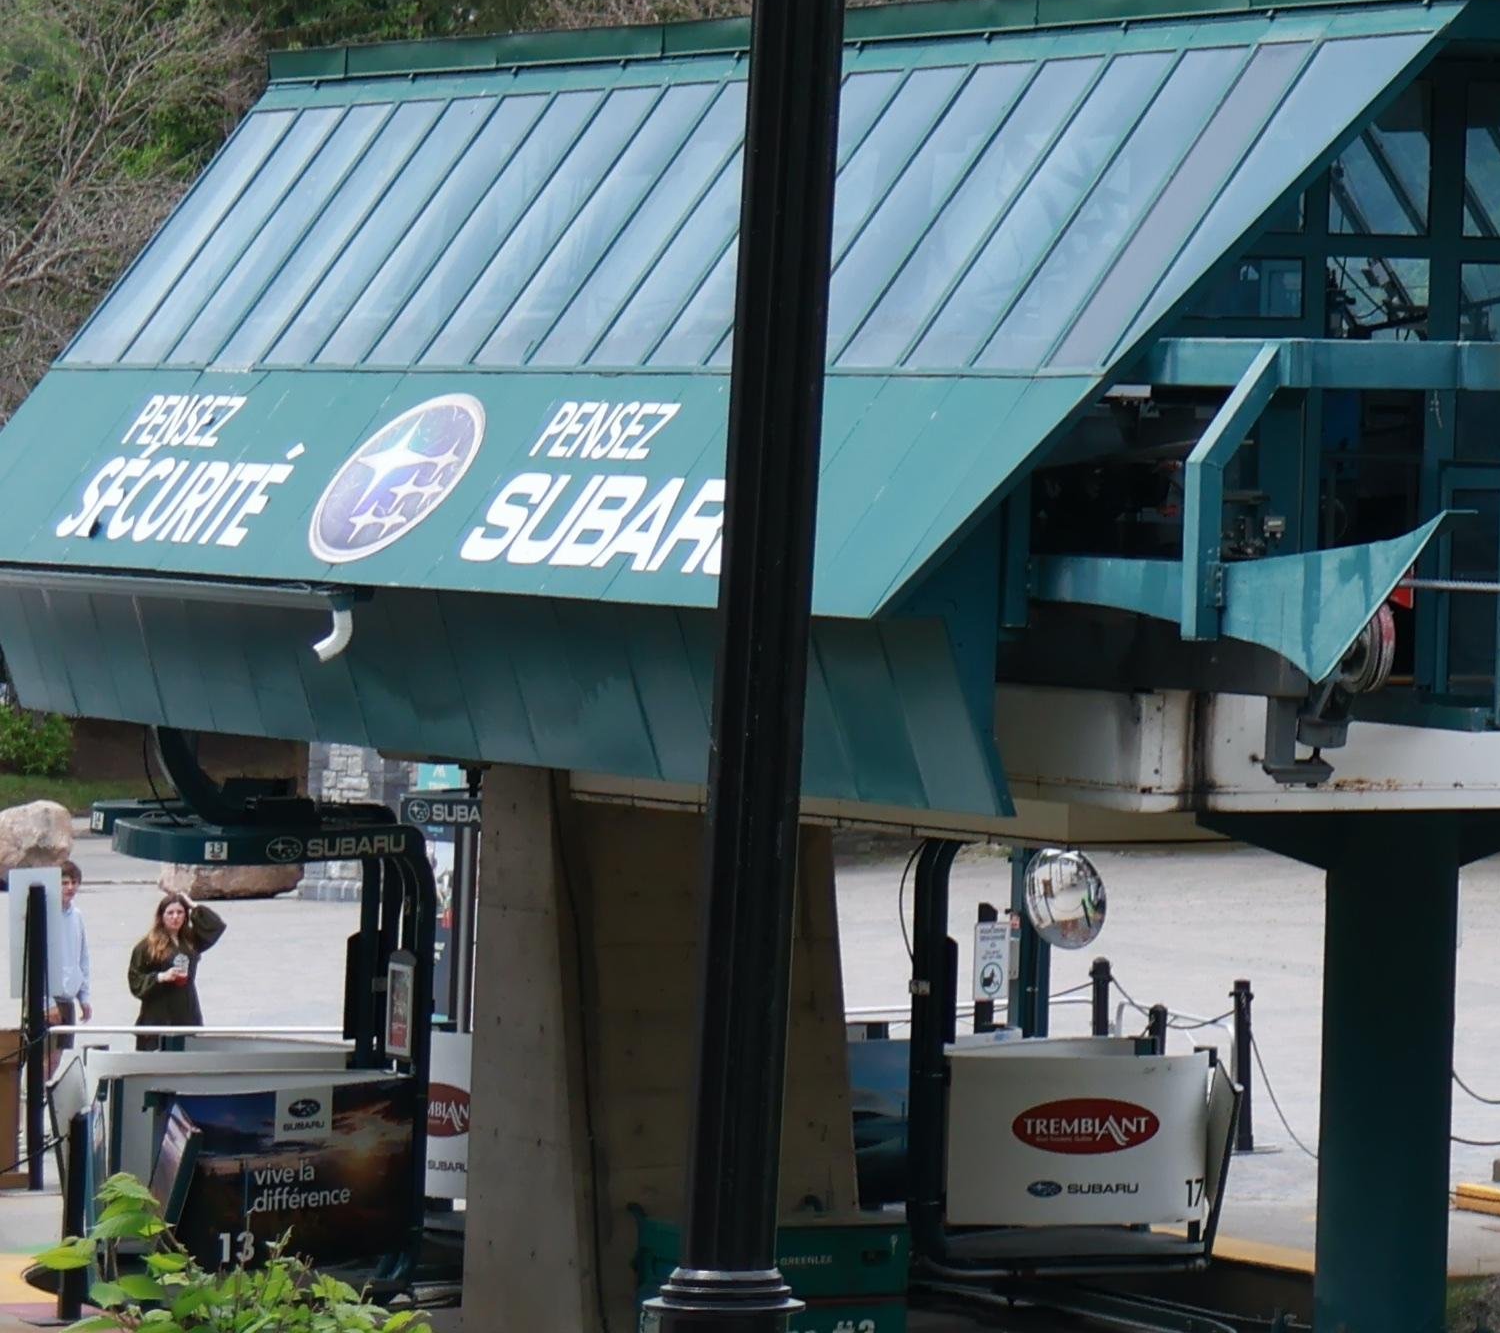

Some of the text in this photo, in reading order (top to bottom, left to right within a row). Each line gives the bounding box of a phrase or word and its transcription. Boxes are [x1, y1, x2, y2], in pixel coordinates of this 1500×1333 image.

[120, 393, 248, 448] PENSEZ
[528, 401, 682, 460] PENSEZ
[56, 442, 305, 547] SÉCURITÉ
[460, 472, 727, 576] SUBAR
[432, 804, 481, 824] SUBA
[306, 835, 405, 858] SUBARU
[283, 1121, 325, 1131] SUBARU
[254, 1164, 295, 1185] vive
[1067, 1183, 1139, 1194] SUBARU
[253, 1186, 351, 1213] différence
[1185, 1179, 1204, 1208] 17
[219, 1232, 255, 1263] 13
